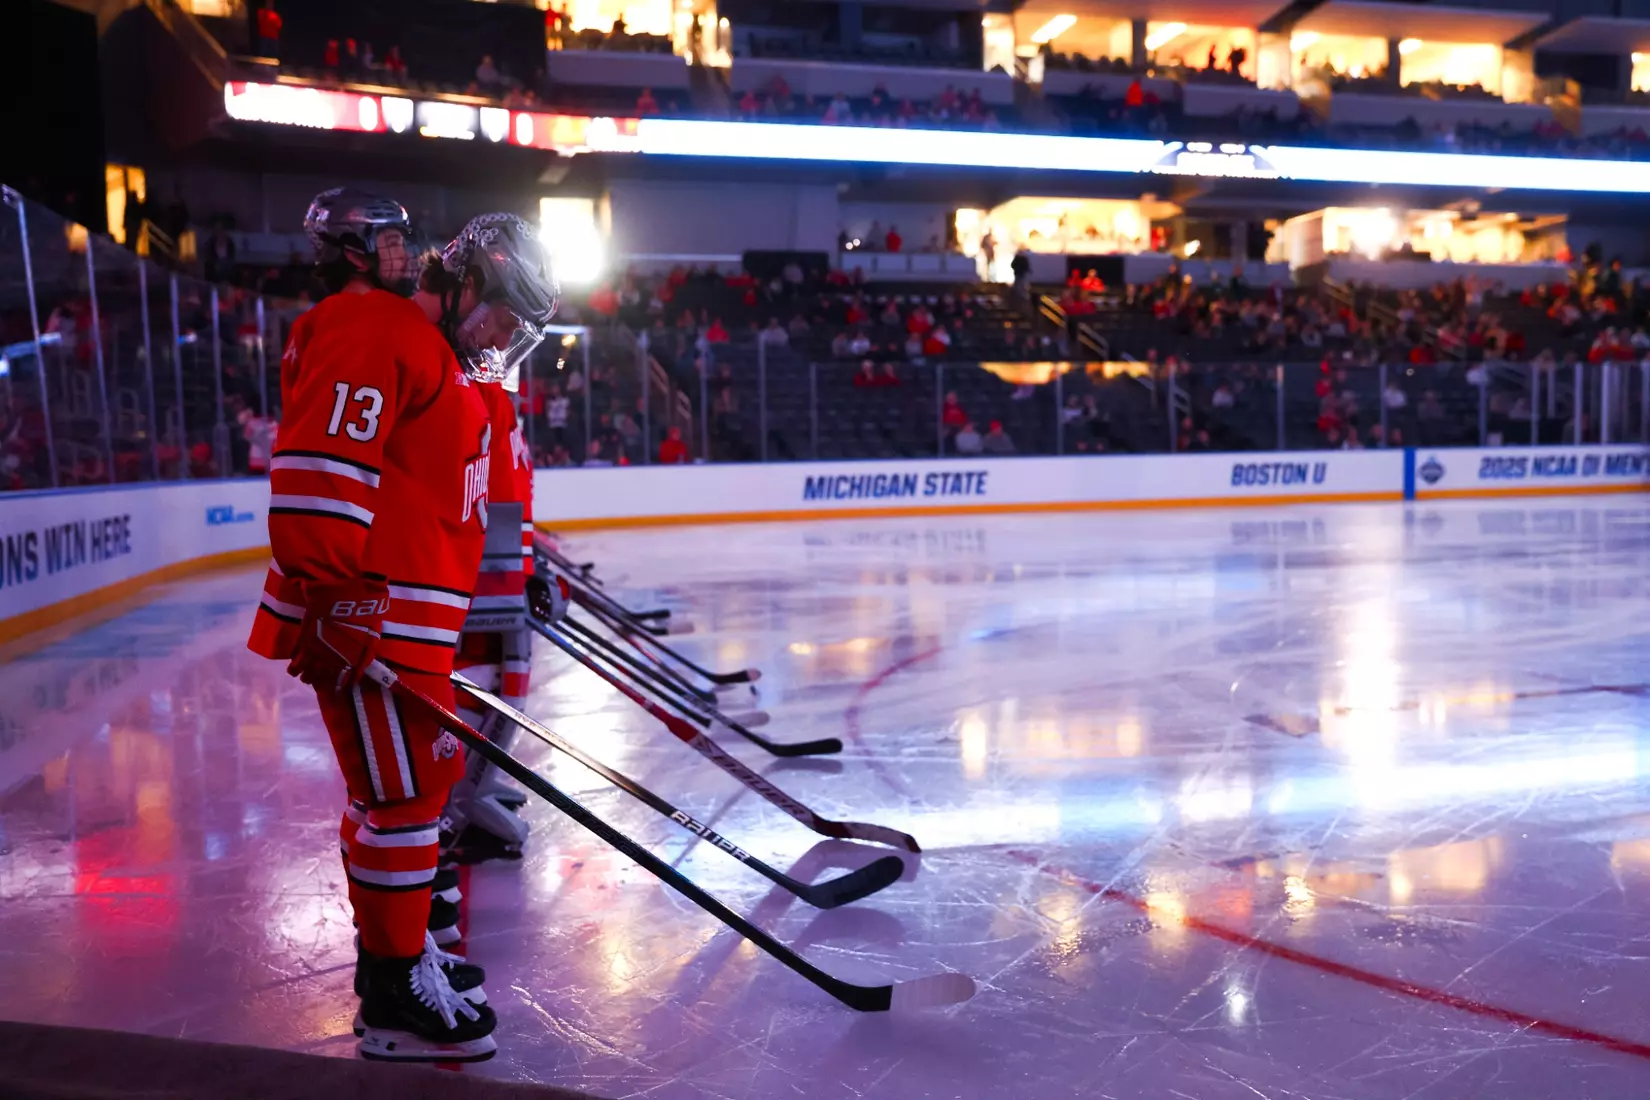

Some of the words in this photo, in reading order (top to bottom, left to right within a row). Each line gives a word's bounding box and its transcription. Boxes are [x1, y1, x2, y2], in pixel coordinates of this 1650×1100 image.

[327, 381, 384, 442] 13
[1231, 464, 1307, 487] BOSTON
[1311, 462, 1327, 485] U
[1479, 455, 1528, 478] 2025
[1532, 454, 1576, 476] NCAA
[803, 472, 917, 500] MICHIGAN
[923, 470, 988, 497] STATE
[0, 530, 38, 590] NS
[44, 520, 86, 576] WIN
[90, 514, 132, 564] HERE
